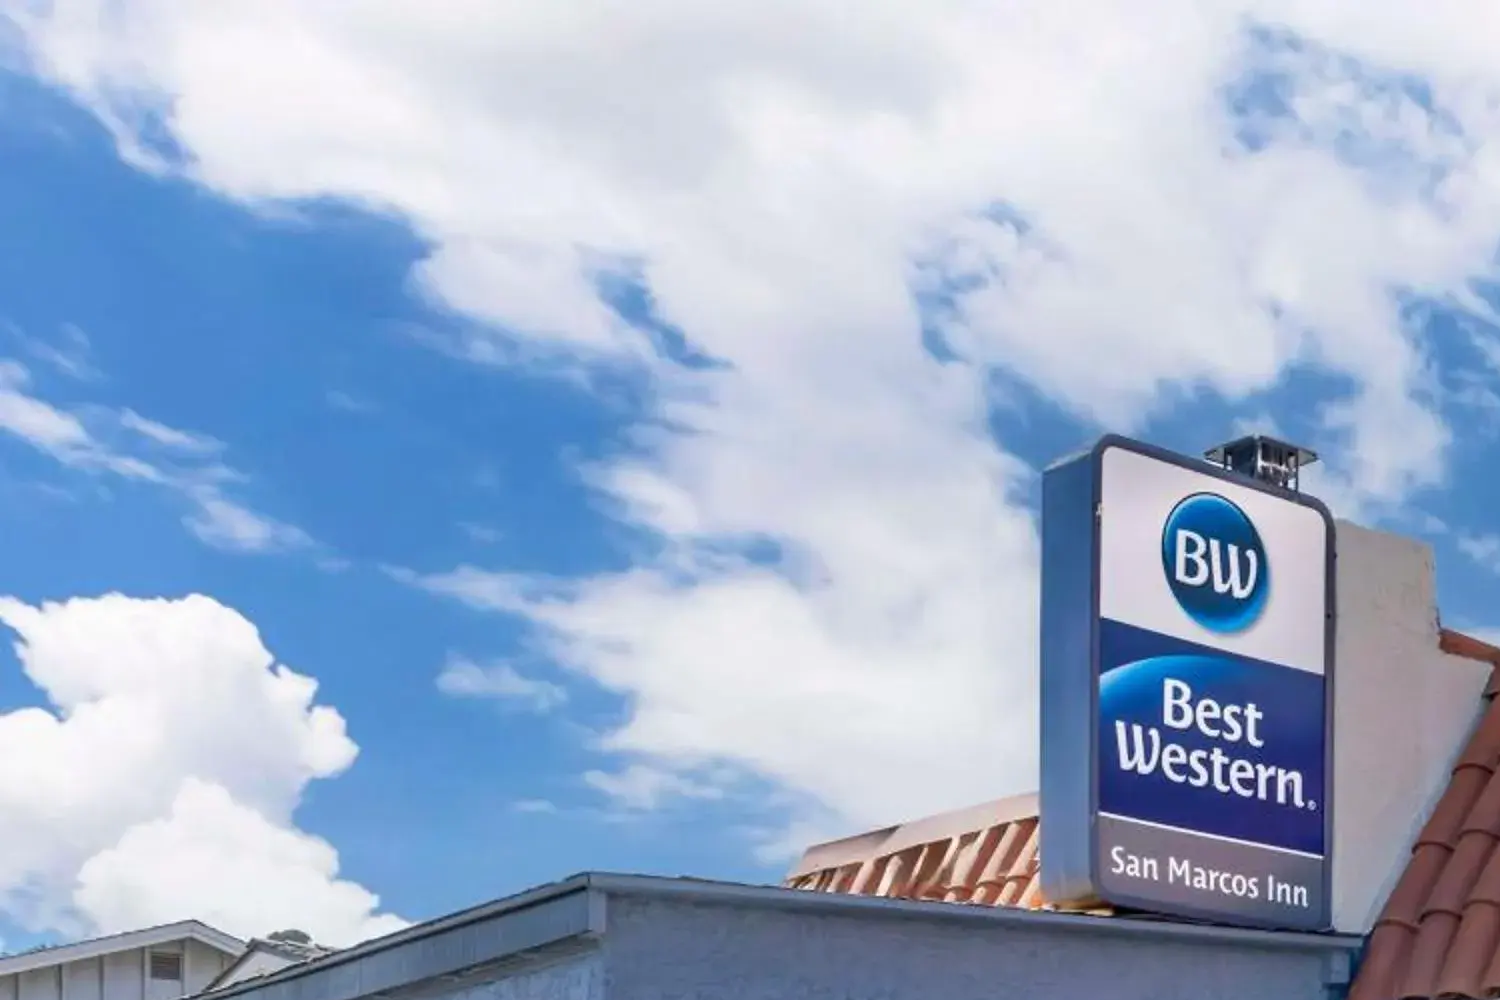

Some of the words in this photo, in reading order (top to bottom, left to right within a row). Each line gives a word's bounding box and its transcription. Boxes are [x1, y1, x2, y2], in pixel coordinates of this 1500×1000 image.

[1175, 528, 1257, 599] BW
[1162, 677, 1265, 748] Best
[1111, 845, 1159, 881] San
[1168, 856, 1259, 899] Marcos
[1267, 874, 1309, 908] Inn
